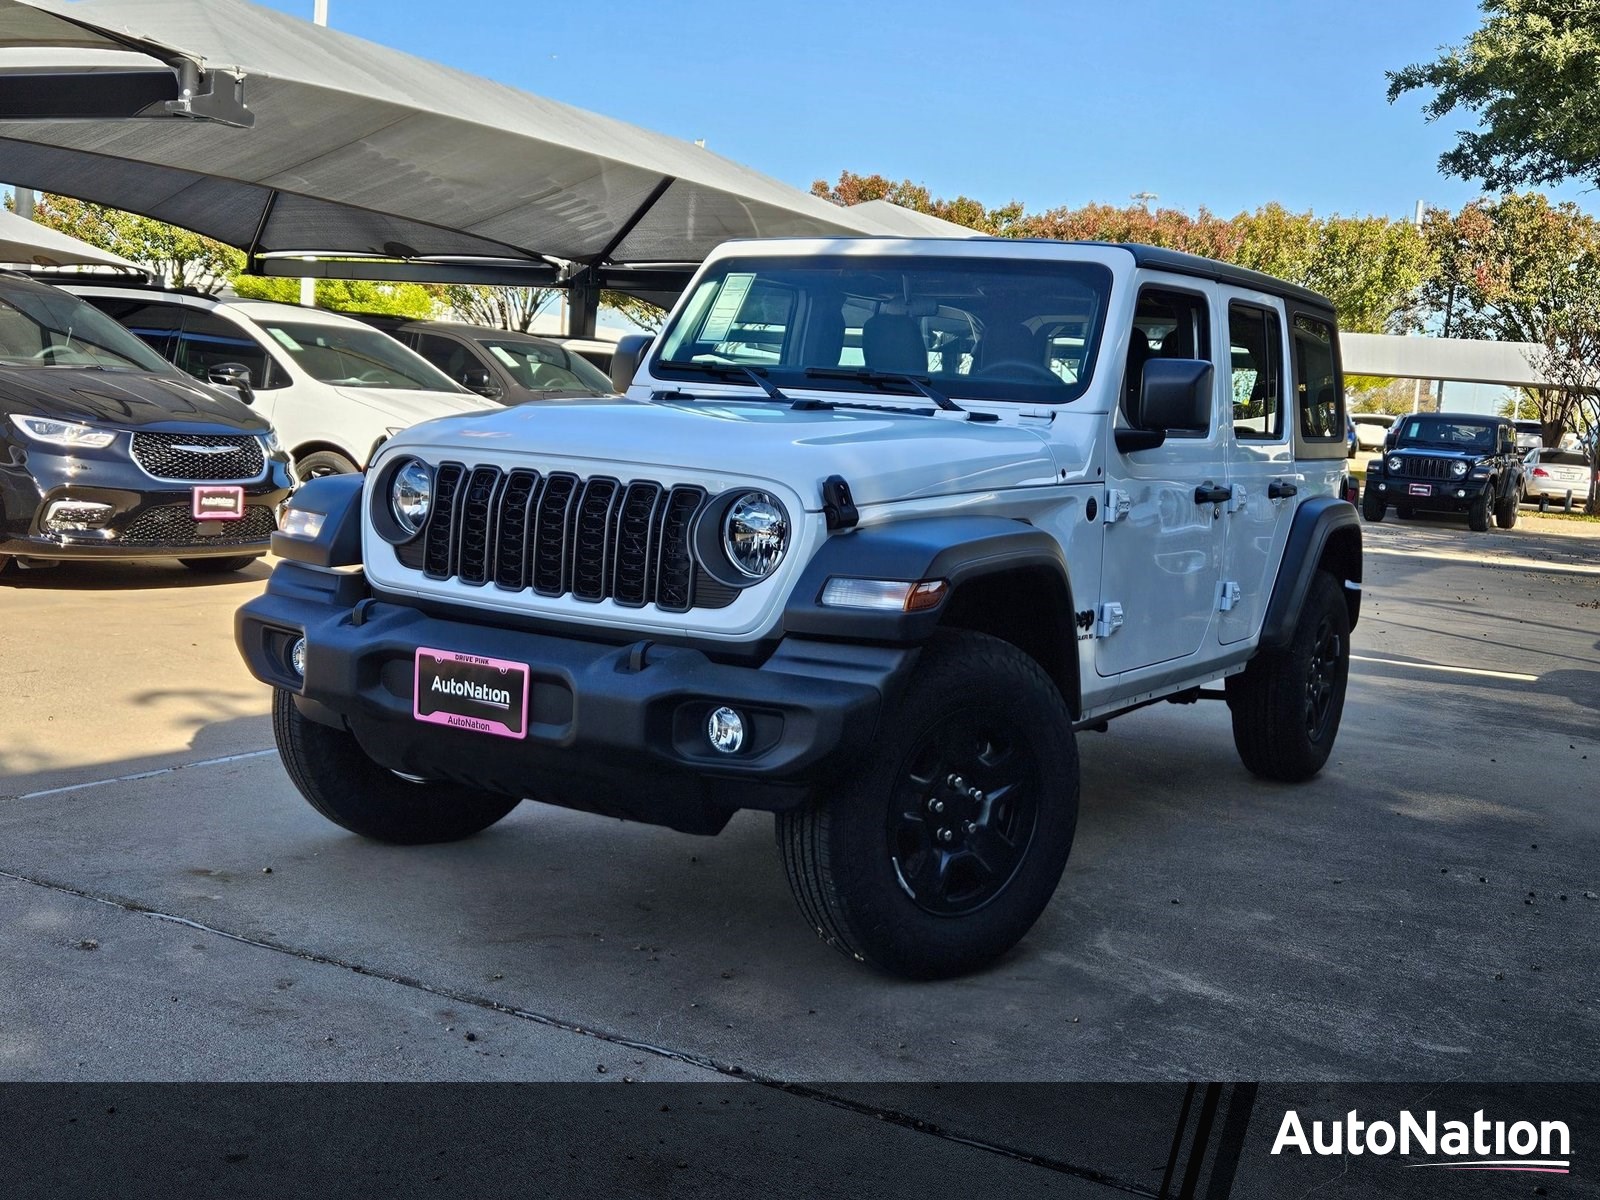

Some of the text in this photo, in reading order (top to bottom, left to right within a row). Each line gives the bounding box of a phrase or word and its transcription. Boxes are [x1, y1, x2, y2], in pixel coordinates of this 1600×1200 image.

[454, 654, 490, 666] DRIVE PINK
[431, 675, 510, 704] AutoNation
[447, 715, 490, 732] AutoNation
